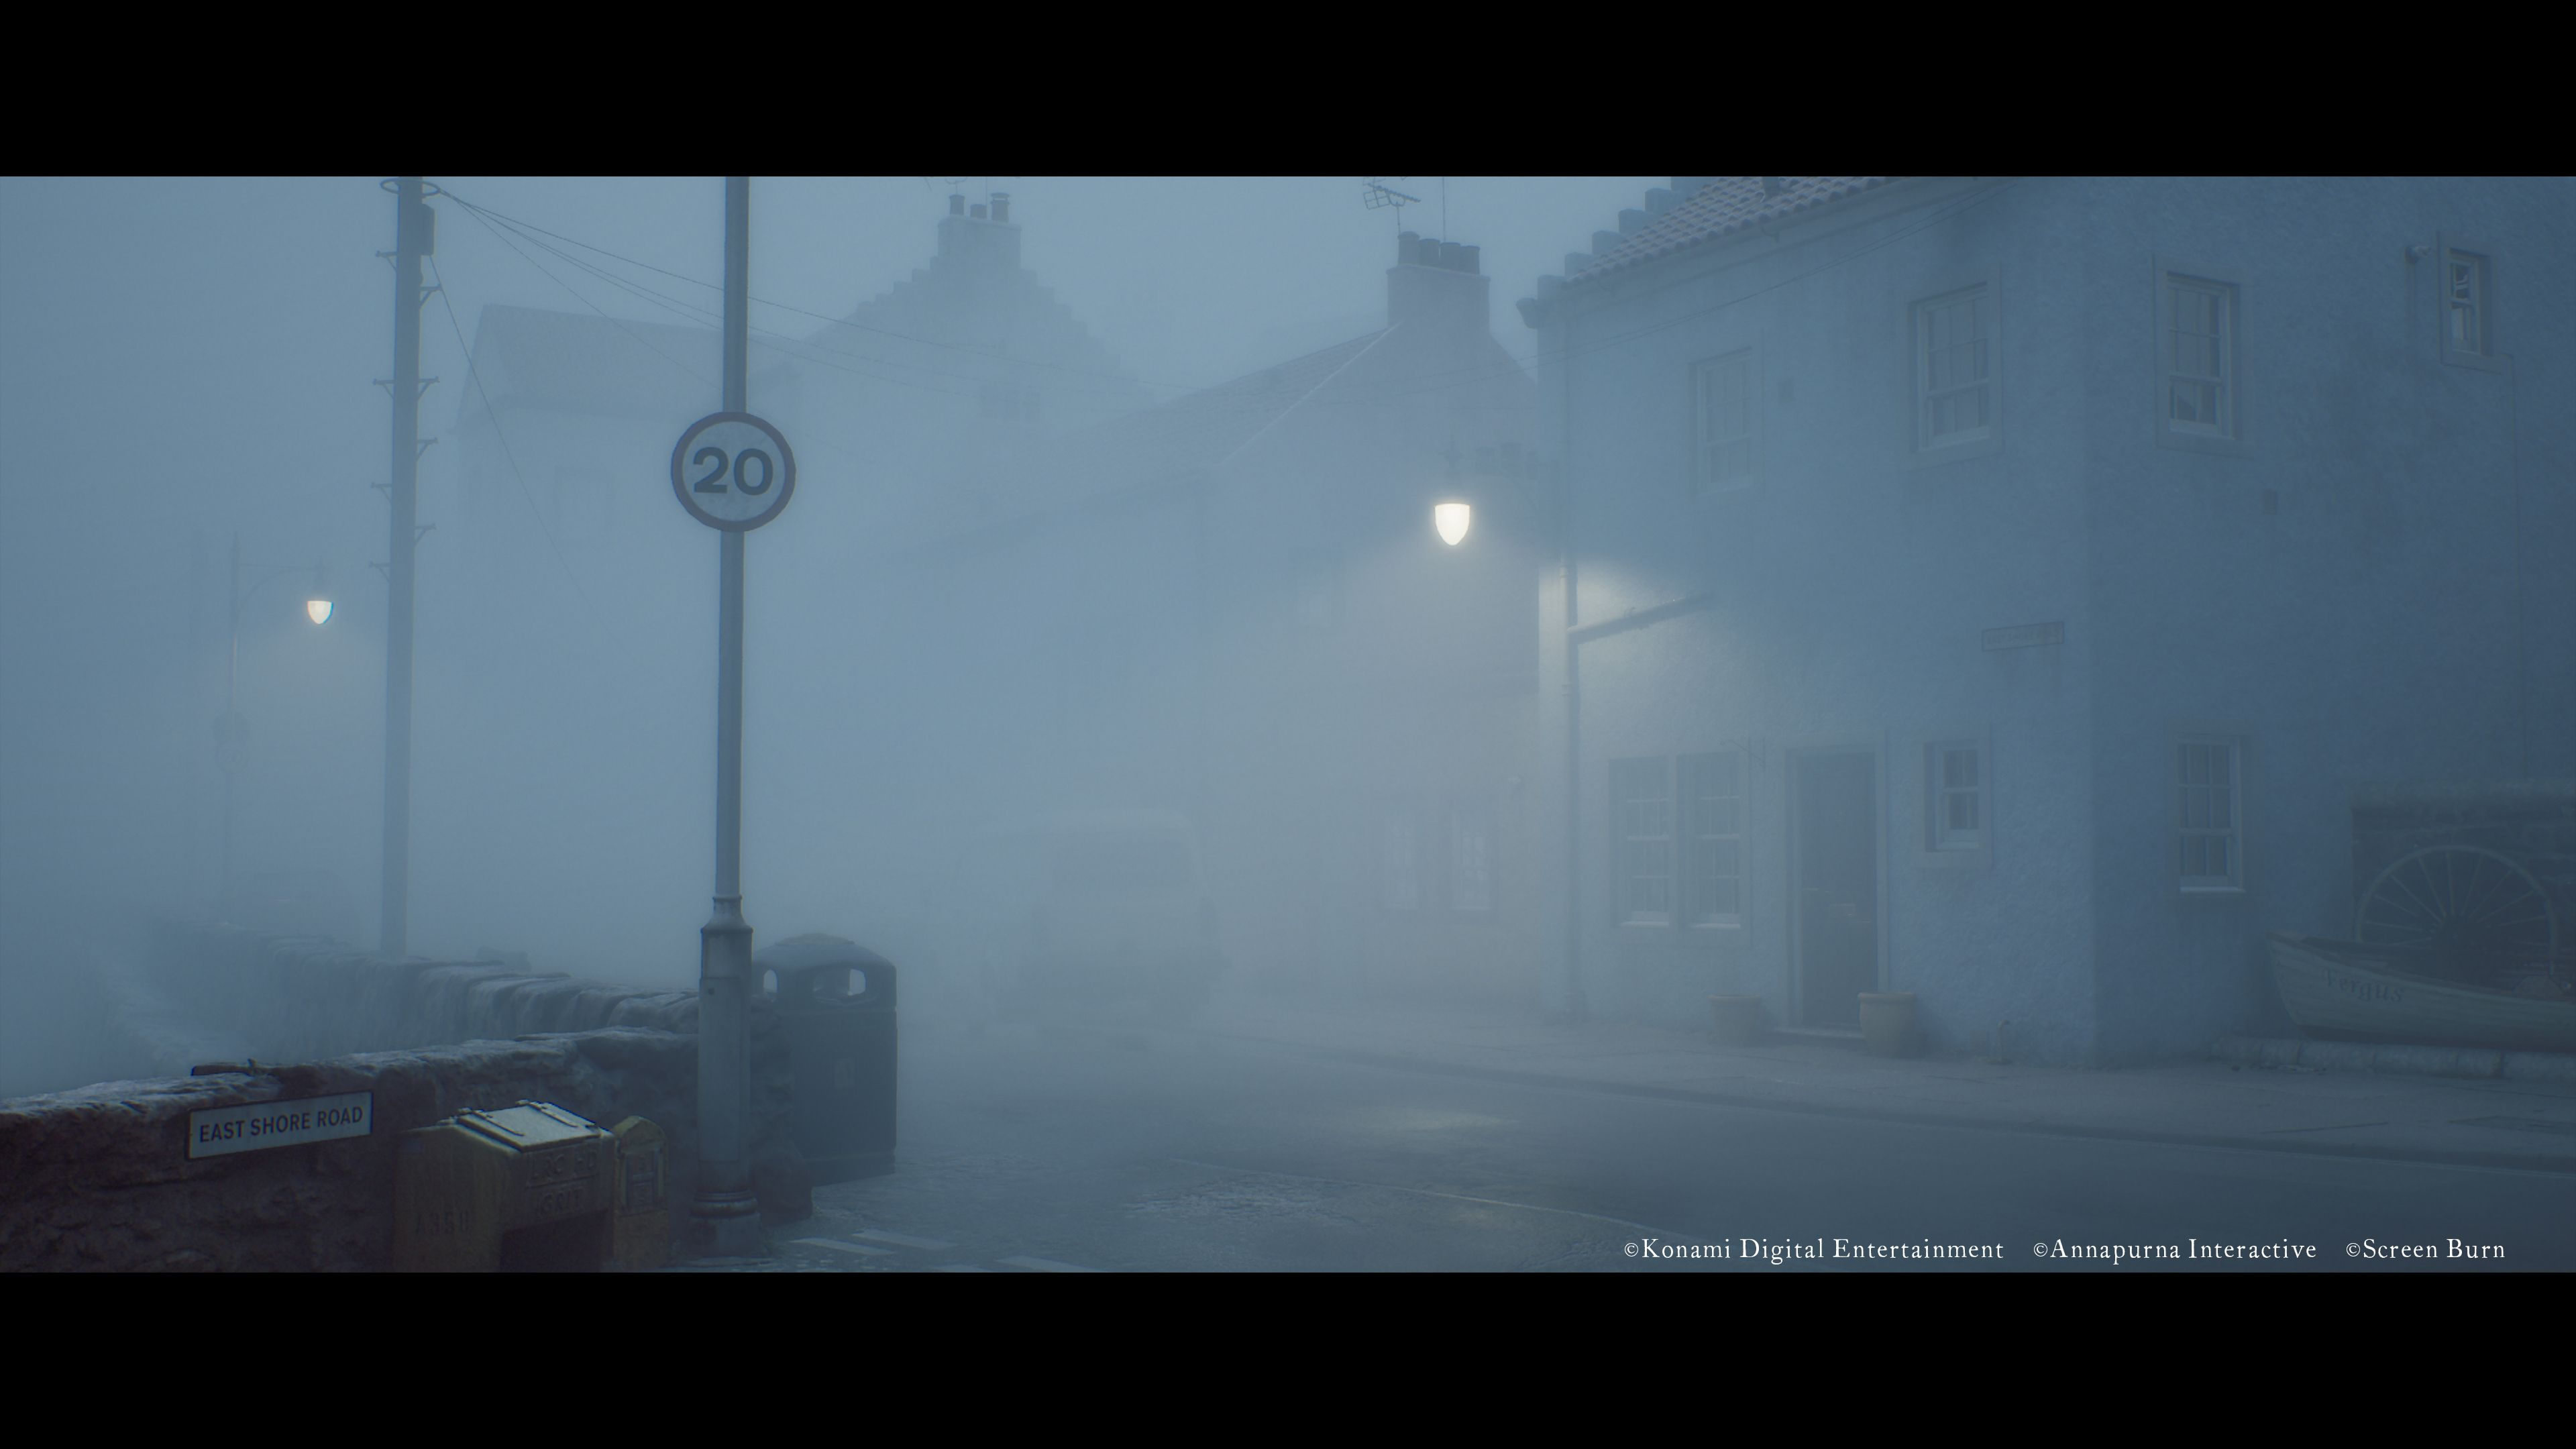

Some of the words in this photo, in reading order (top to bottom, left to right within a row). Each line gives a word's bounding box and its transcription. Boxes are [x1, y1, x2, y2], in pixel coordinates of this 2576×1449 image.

[693, 447, 773, 495] 20
[2321, 967, 2405, 1002] Fergus
[199, 1120, 245, 1142] EAST
[251, 1113, 310, 1136] SHORE
[317, 1107, 363, 1127] ROAD
